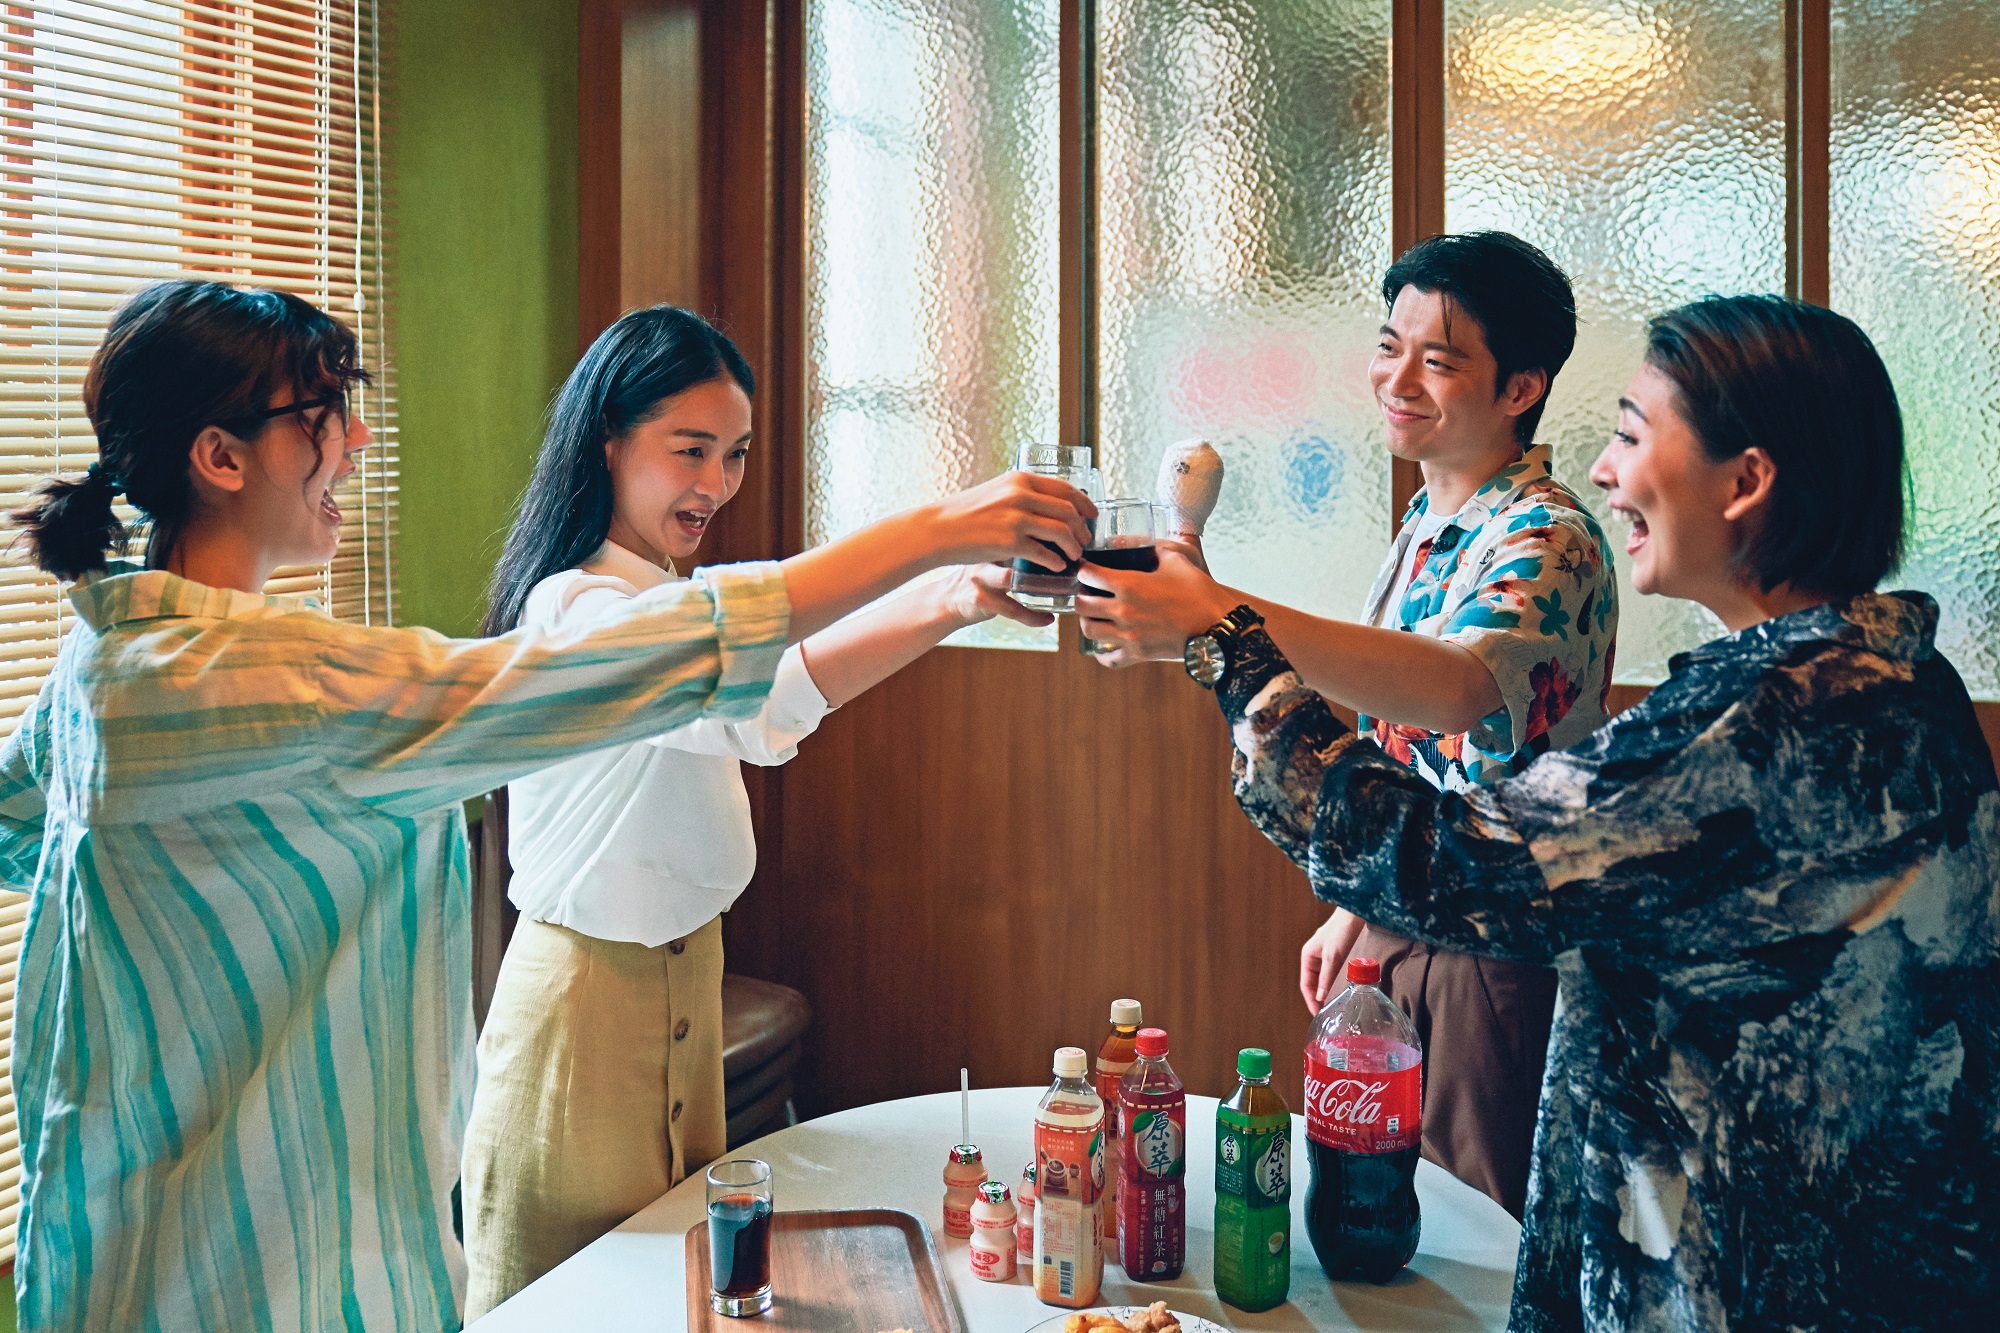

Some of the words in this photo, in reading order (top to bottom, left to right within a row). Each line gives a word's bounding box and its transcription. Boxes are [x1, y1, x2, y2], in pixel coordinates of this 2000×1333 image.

[1142, 1111, 1172, 1179] 原萃
[1328, 1122, 1357, 1136] TASTE
[1375, 1139, 1396, 1150] 2000
[1262, 1131, 1287, 1202] 原萃
[1154, 1188, 1166, 1257] 無糖紅茶
